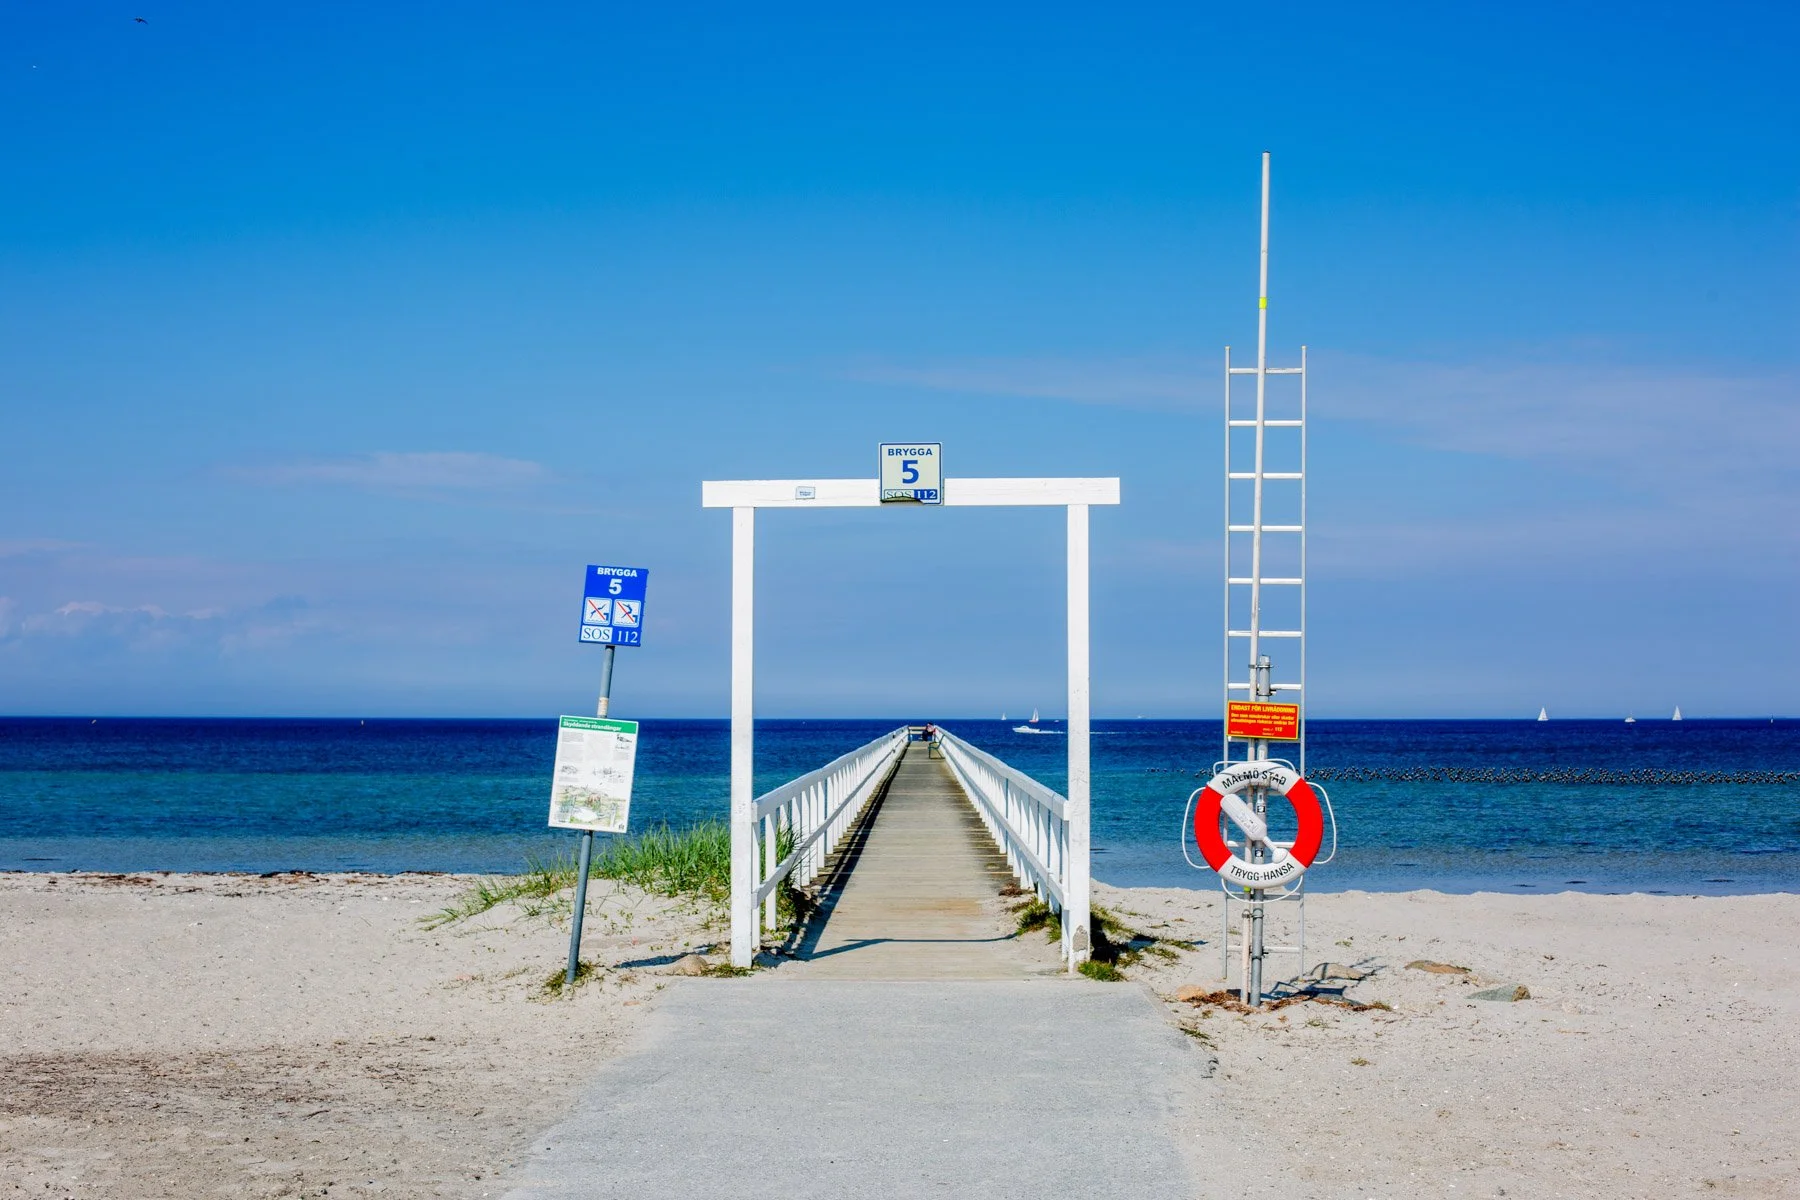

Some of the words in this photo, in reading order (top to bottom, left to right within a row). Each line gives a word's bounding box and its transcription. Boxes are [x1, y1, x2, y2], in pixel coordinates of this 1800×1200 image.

[888, 448, 933, 456] BRYGGA
[902, 460, 919, 484] 5
[886, 490, 912, 498] SOS
[917, 490, 936, 499] 112
[597, 567, 638, 577] BRYGGA
[608, 578, 622, 595] 5
[583, 627, 610, 640] SOS
[617, 630, 638, 643] 112
[1221, 767, 1260, 789] MALMÖ
[1261, 770, 1287, 786] STAD
[1229, 862, 1295, 881] TRYGG-HANSA
